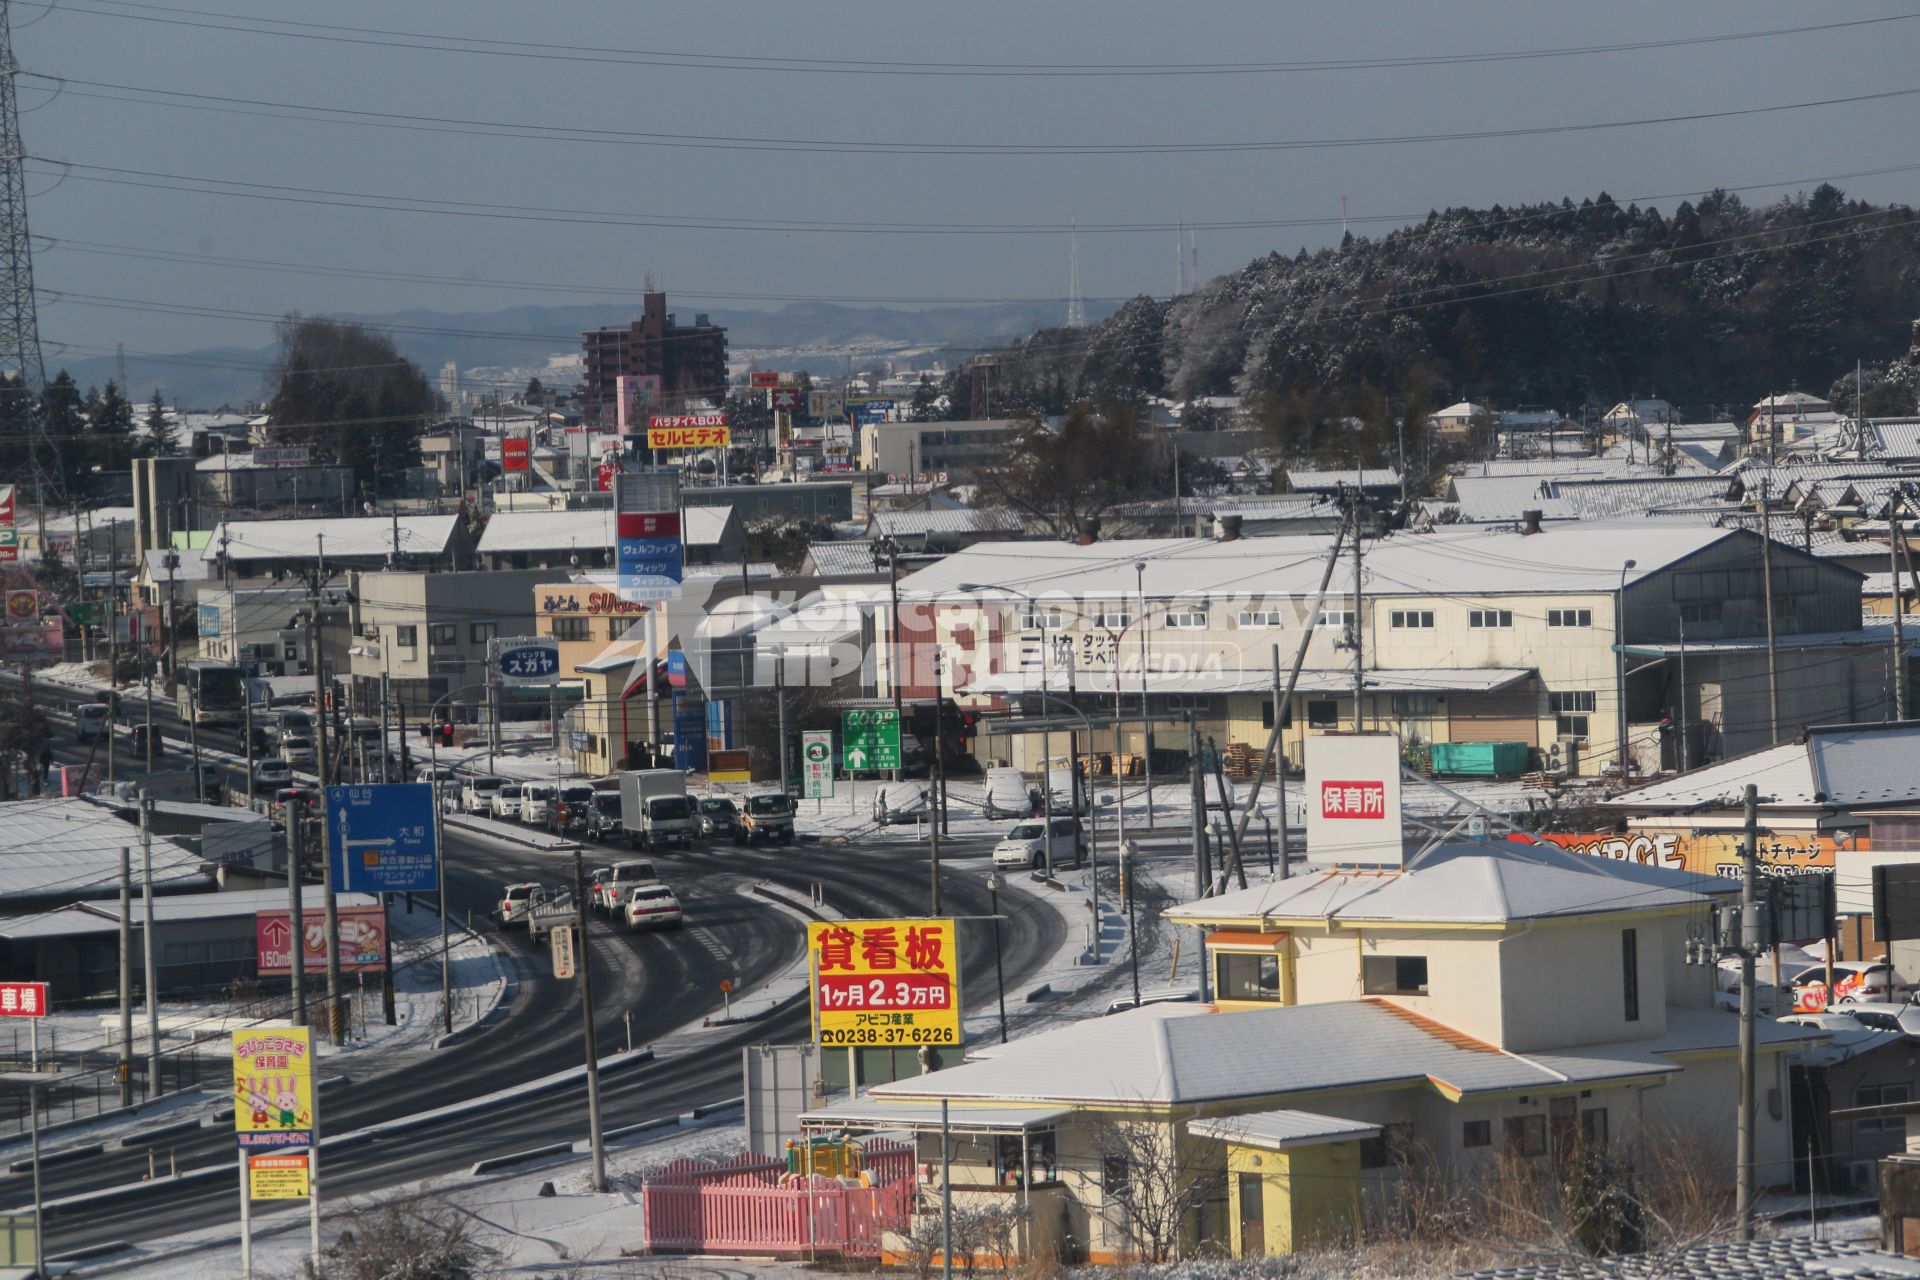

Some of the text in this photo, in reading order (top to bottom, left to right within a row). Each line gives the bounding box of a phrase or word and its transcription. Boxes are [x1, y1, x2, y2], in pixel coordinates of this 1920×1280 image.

[654, 415, 723, 427] パラダイスBOX
[651, 428, 727, 447] セルビデオ
[543, 594, 580, 613] ふとん
[509, 658, 554, 674] スガヤ
[847, 711, 895, 726] COOP
[349, 788, 372, 799] 仙台
[1323, 786, 1383, 813] 保育所
[399, 826, 425, 838] 大和
[304, 920, 380, 950] クヨン
[816, 926, 945, 971] 貸看板
[1, 986, 37, 1013] 車場
[855, 1013, 914, 1025] アビコ産業
[835, 1028, 953, 1043] 0238-37-6226
[237, 1036, 306, 1059] ちびっこうさぎ
[255, 1054, 289, 1070] 保育園
